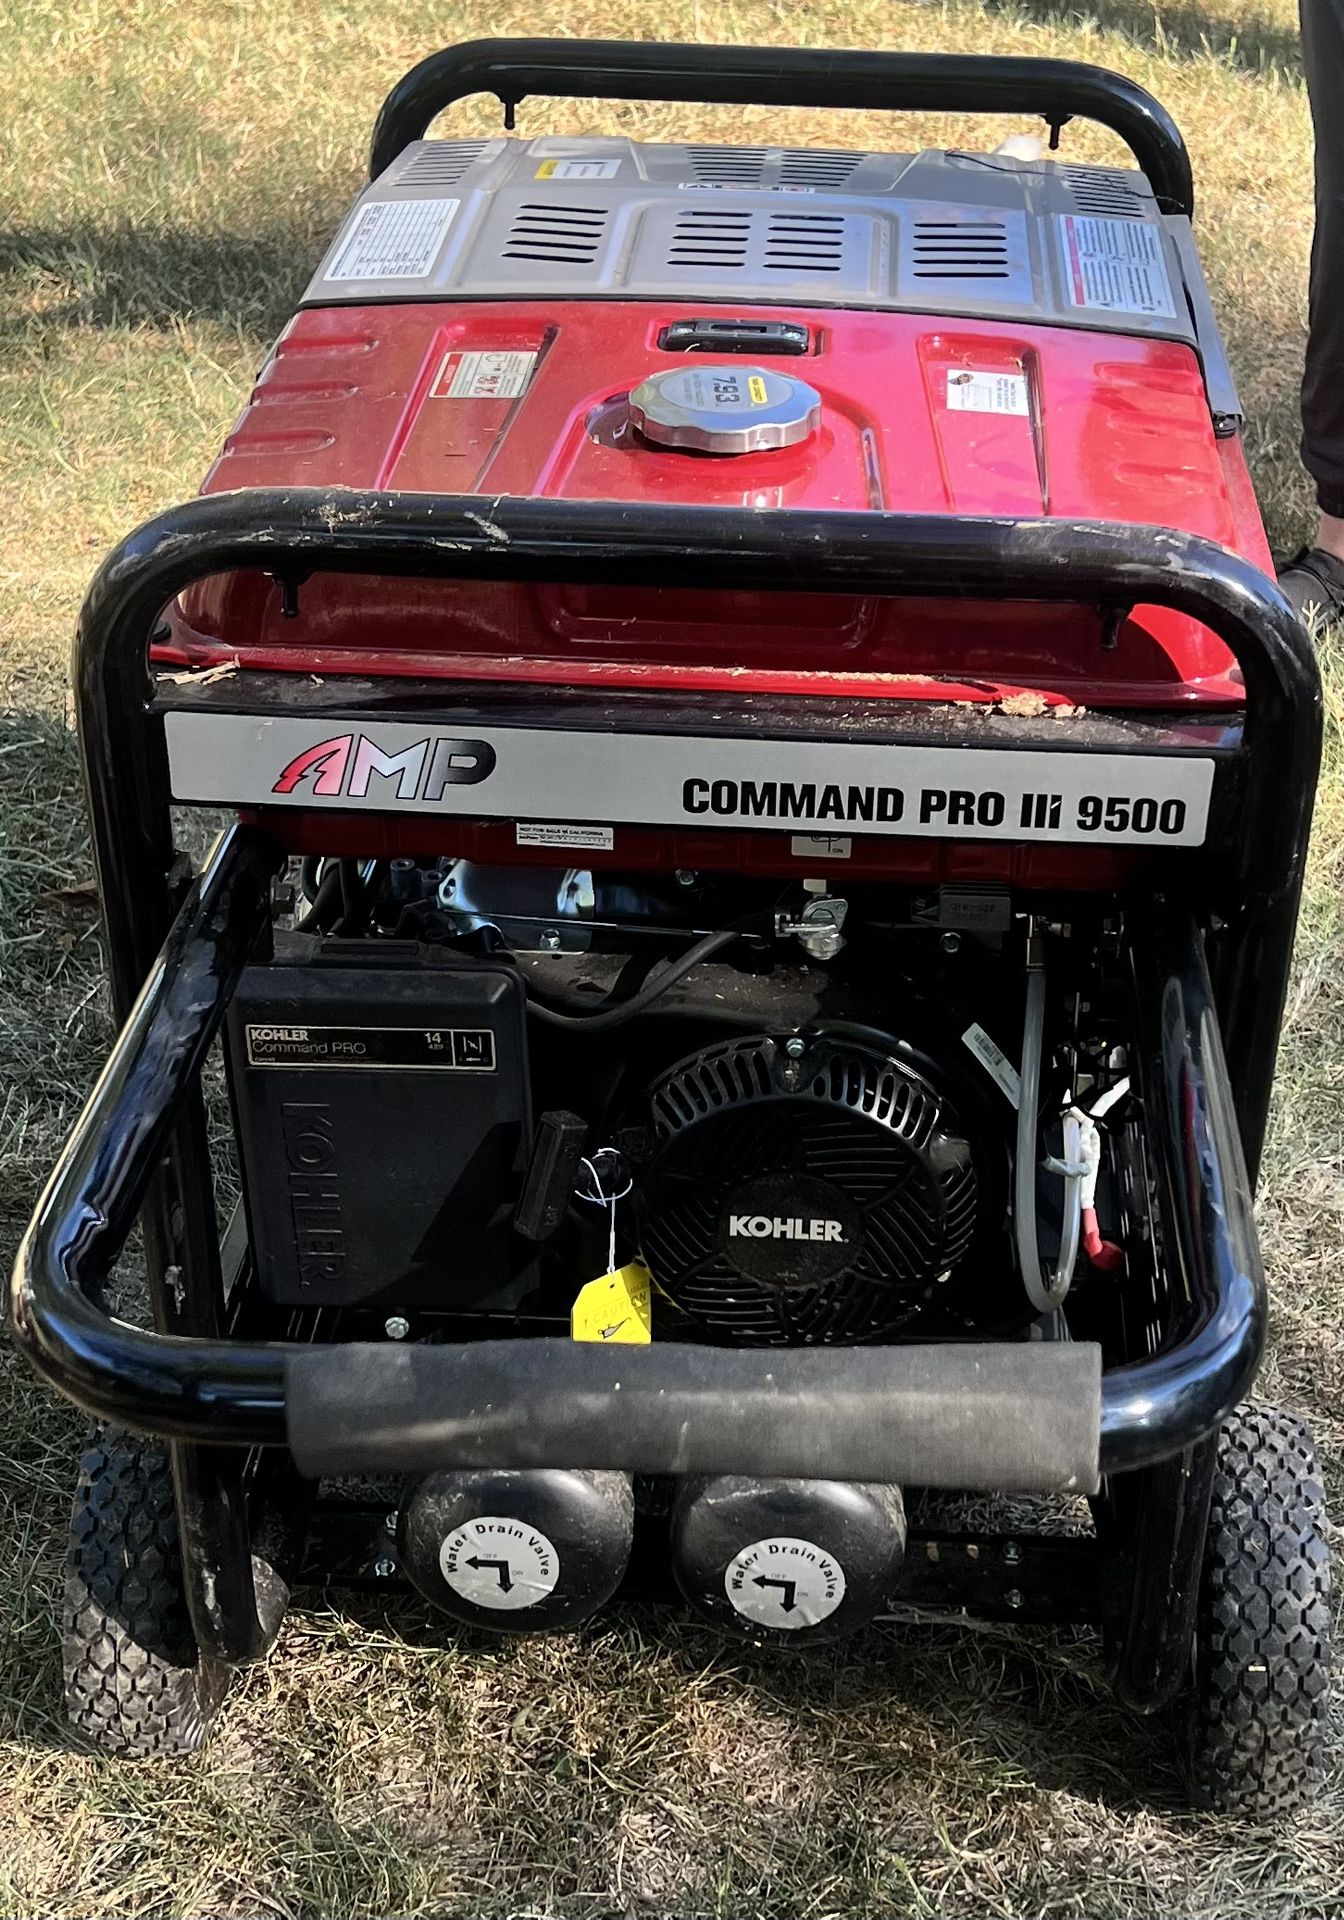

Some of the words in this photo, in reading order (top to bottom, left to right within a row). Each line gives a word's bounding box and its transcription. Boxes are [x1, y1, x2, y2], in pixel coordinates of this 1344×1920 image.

[271, 733, 497, 802] AMP
[682, 776, 905, 823] COMMAND
[919, 788, 1006, 827] PRO
[1020, 792, 1063, 829] III
[1076, 795, 1187, 835] 9500
[250, 1028, 309, 1042] KOHLER
[424, 1032, 442, 1044] 14
[252, 1041, 329, 1055] Command
[332, 1041, 367, 1055] PRO
[446, 1533, 468, 1573] Water
[475, 1524, 524, 1539] Drain
[528, 1536, 551, 1576] Valve
[731, 1552, 760, 1590] Water
[768, 1544, 817, 1562] Drain
[818, 1559, 838, 1598] Valve
